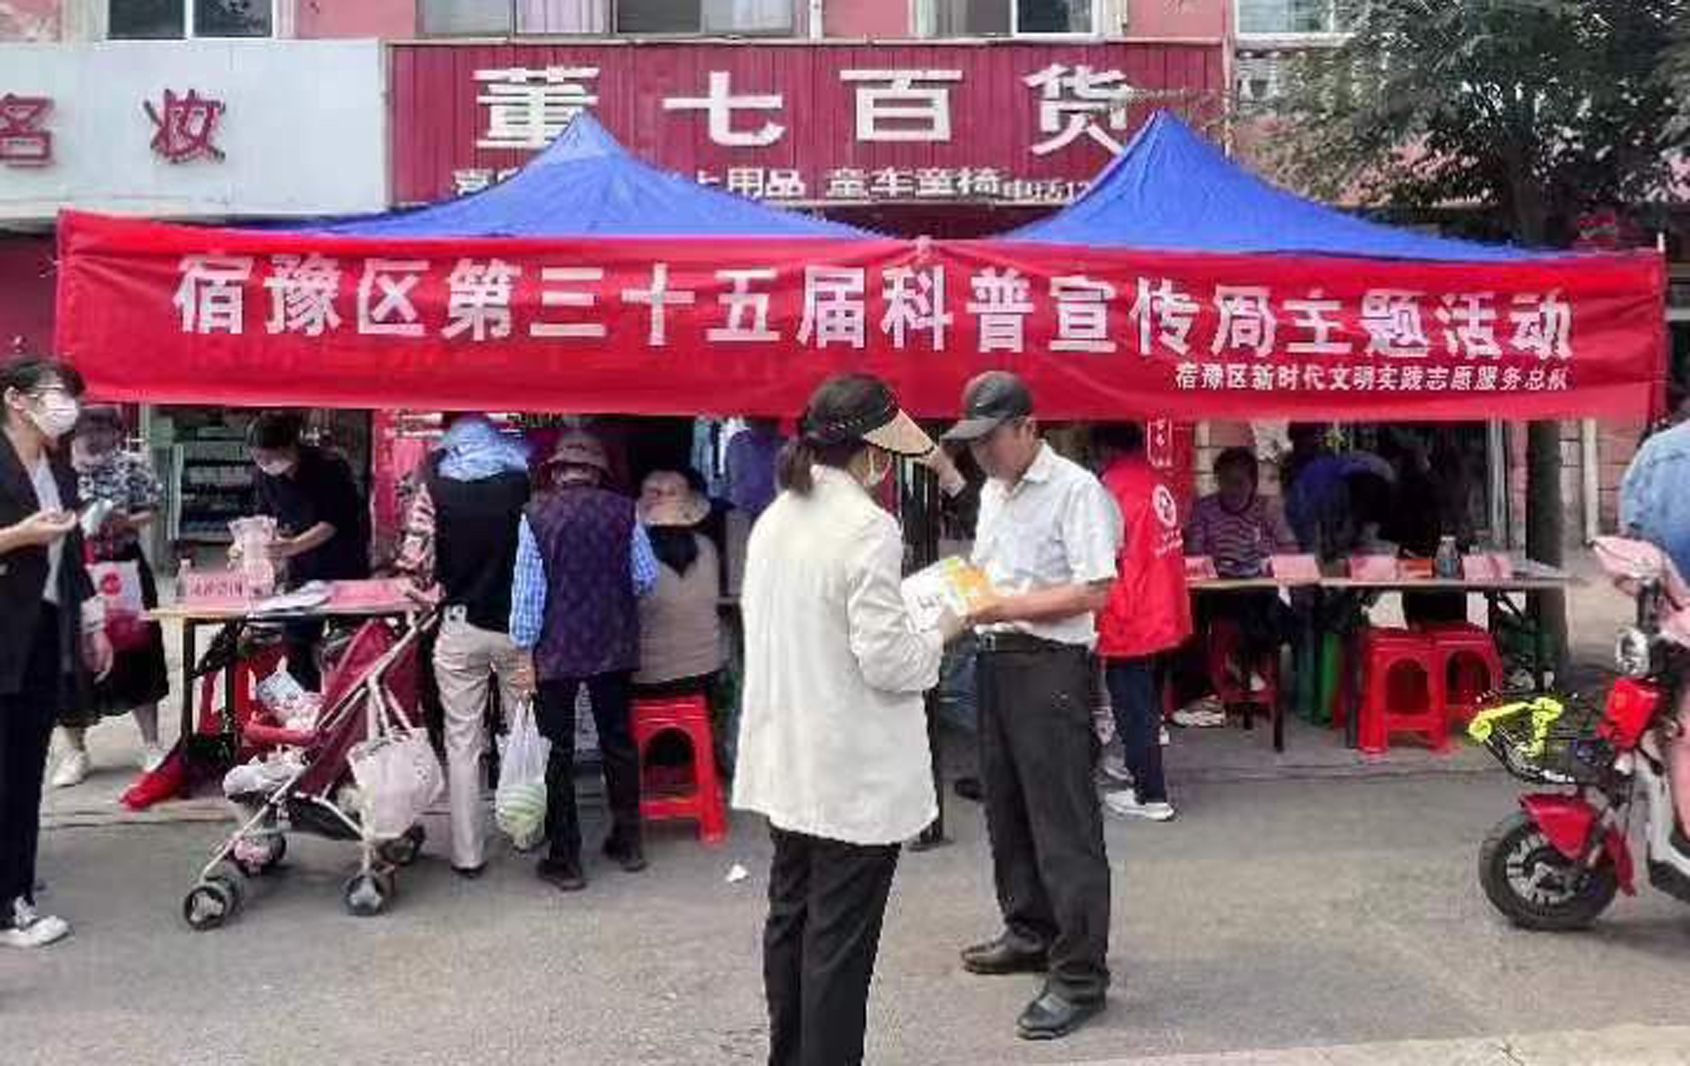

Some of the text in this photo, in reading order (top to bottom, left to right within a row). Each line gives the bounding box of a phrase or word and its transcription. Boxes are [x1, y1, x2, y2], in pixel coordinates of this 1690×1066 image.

[472, 64, 1130, 156] 董七百货
[172, 251, 1574, 361] 宿豫区第三十五届科普宣传周主题活动
